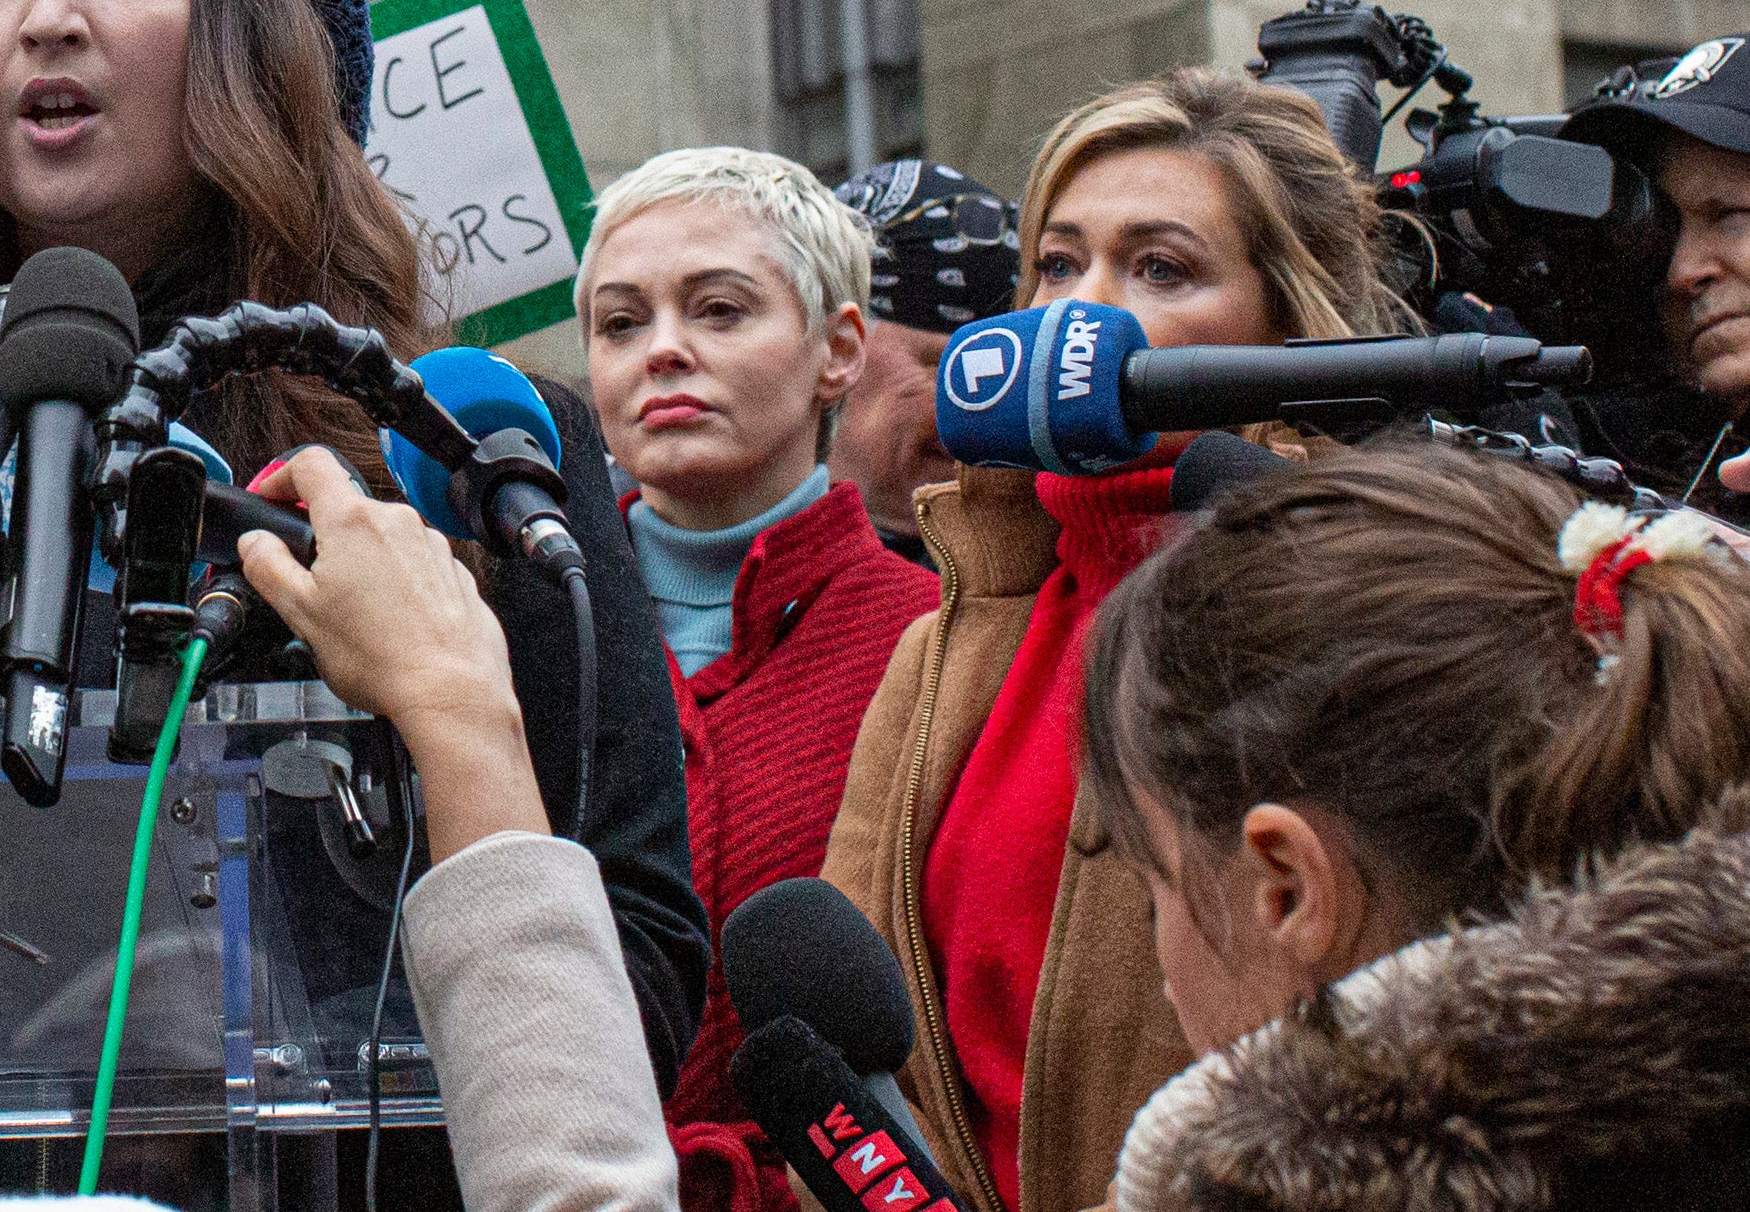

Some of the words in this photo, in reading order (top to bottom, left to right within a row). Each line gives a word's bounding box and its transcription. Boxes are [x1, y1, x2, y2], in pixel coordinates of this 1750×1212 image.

[383, 26, 485, 120] CE
[419, 194, 552, 276] ORS
[1057, 320, 1101, 401] WDR
[823, 1101, 916, 1204] WNY
